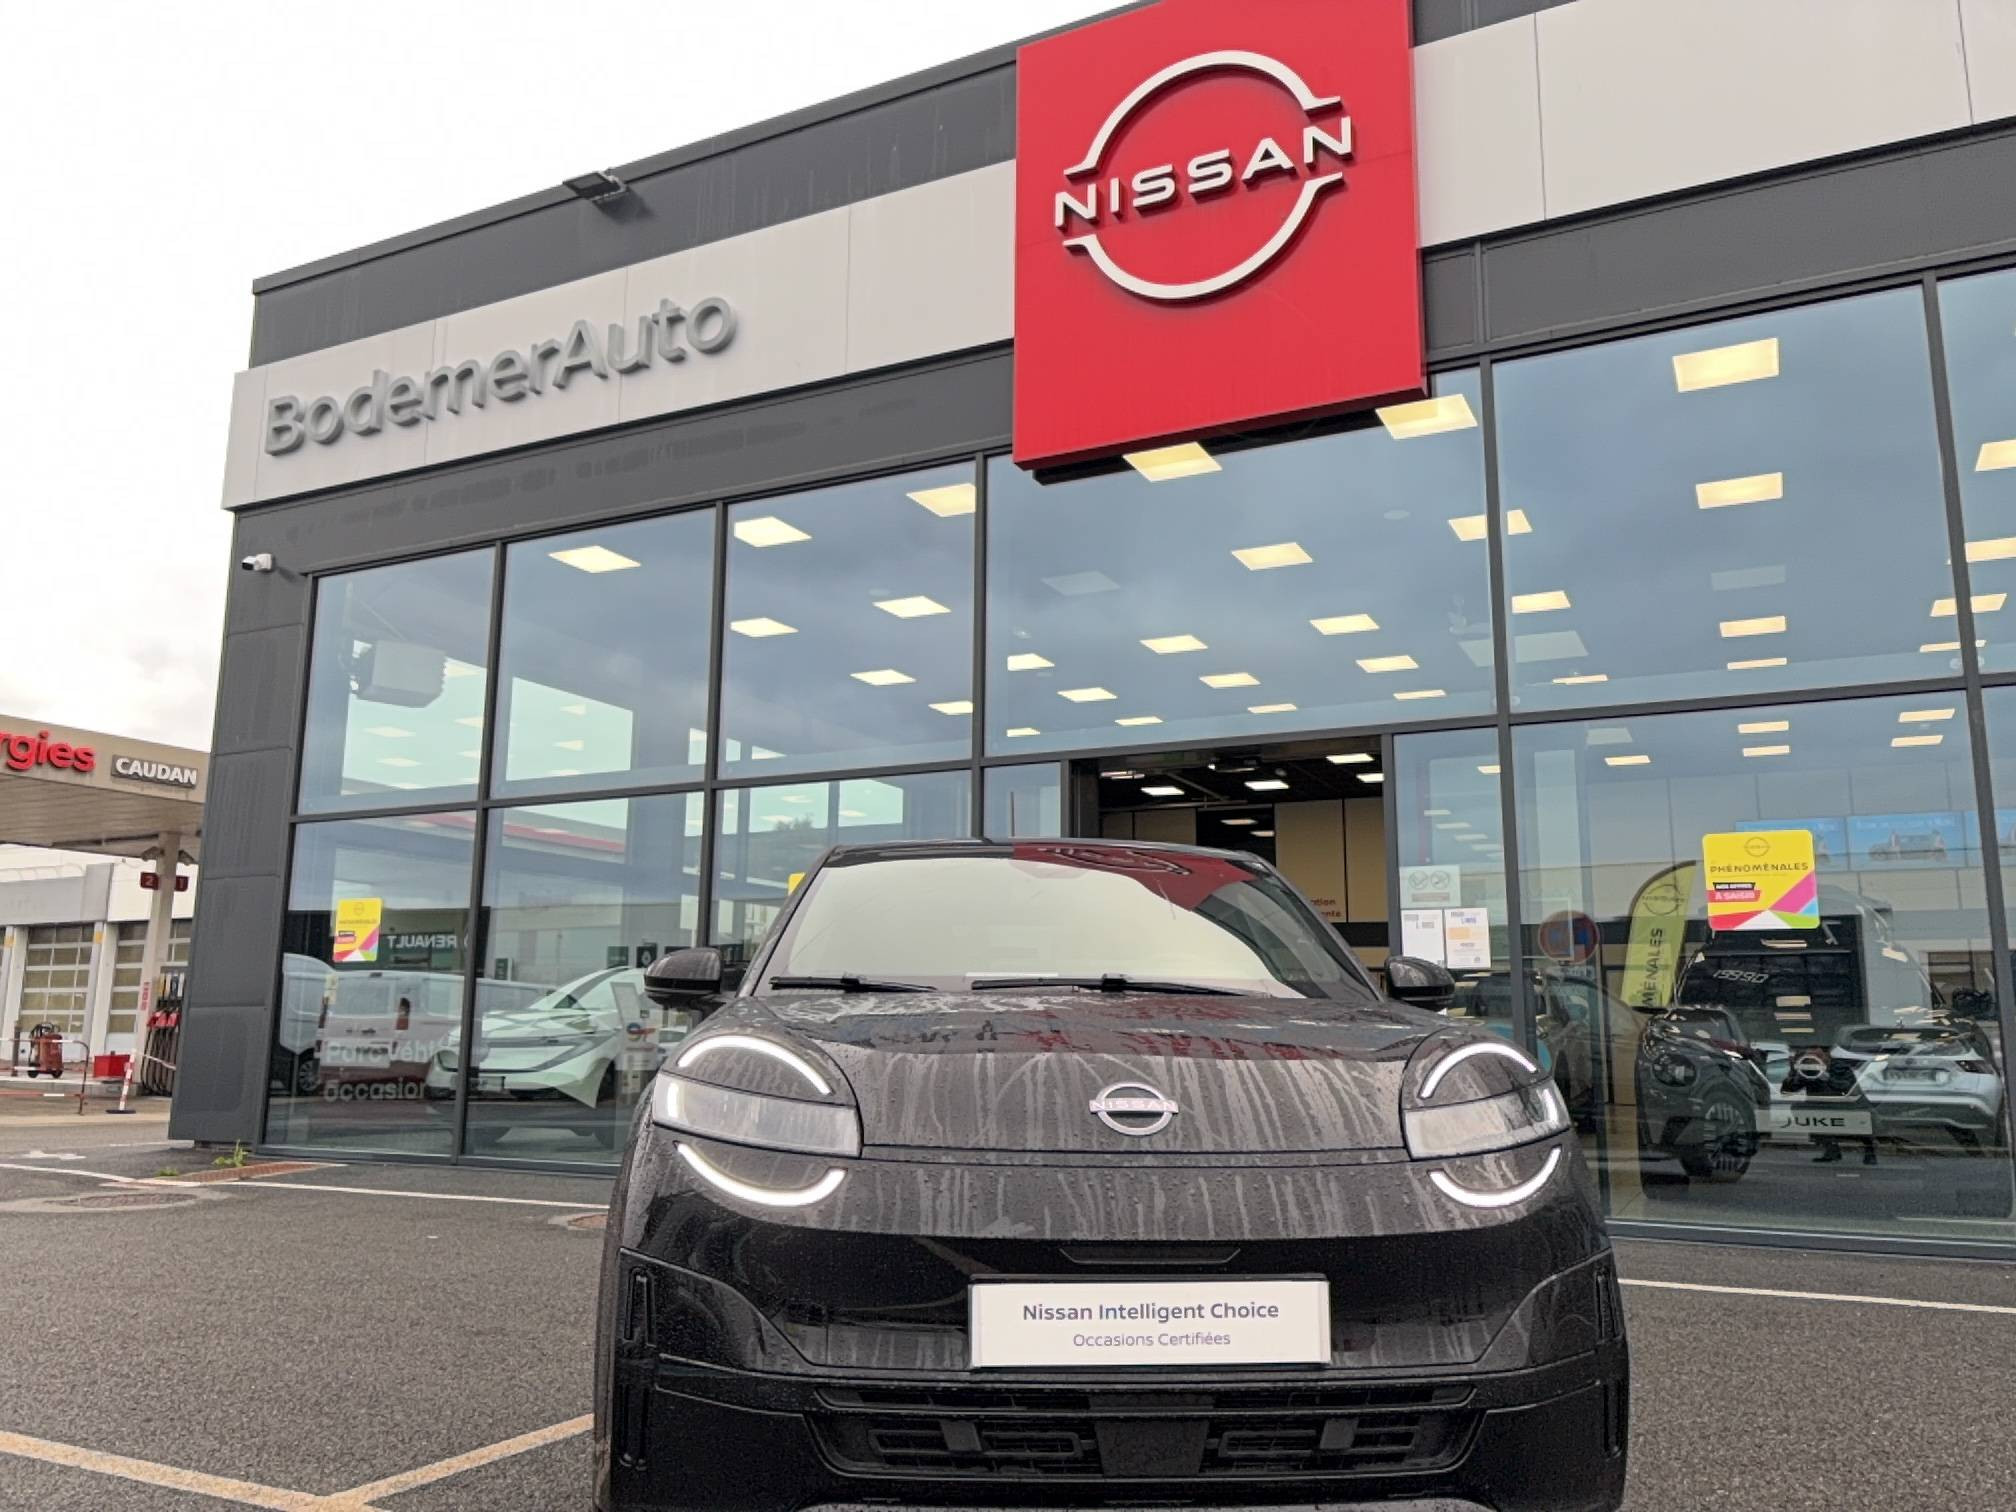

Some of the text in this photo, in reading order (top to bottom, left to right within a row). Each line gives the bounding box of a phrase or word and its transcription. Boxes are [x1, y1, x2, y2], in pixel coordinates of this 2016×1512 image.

[1054, 115, 1354, 232] NISSAN
[265, 296, 738, 456] BodemerAuto
[115, 757, 197, 785] CAUDAN
[1093, 1100, 1177, 1112] NISSAN
[1779, 1116, 1846, 1129] JUKE
[1023, 1300, 1280, 1324] Nissan Intelligent Choice
[1073, 1331, 1231, 1347] Occasions Certifiées
